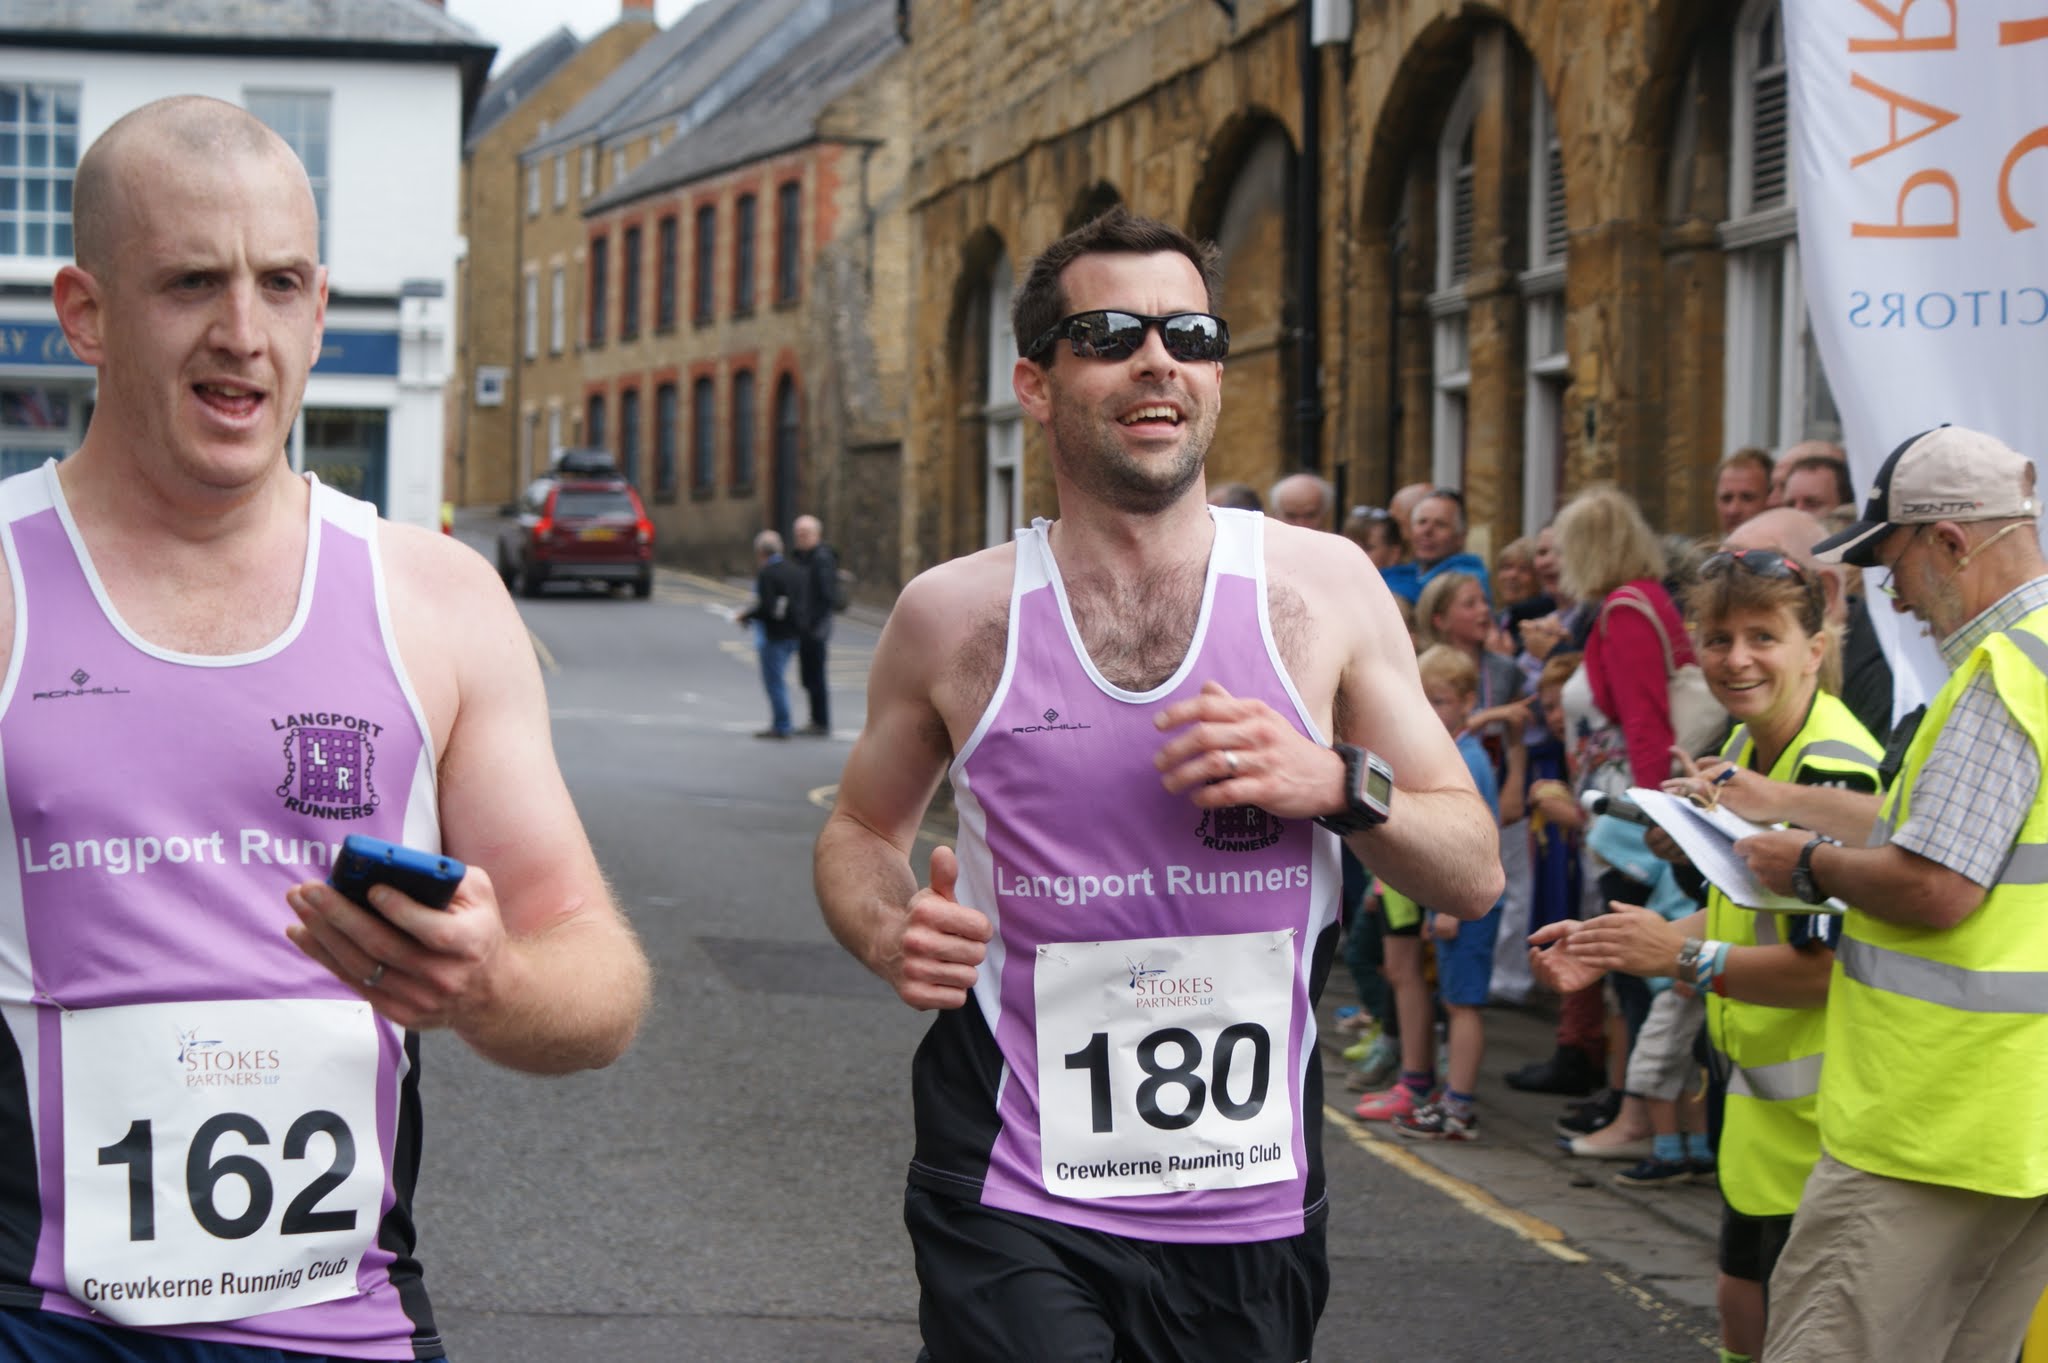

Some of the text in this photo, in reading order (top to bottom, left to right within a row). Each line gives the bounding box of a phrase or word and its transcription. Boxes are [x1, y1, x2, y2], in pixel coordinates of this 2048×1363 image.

[33, 687, 130, 701] RONHILL
[270, 712, 384, 739] LANGPORT
[1011, 723, 1091, 735] RONHILL
[284, 797, 375, 821] RUNNERS
[22, 830, 224, 875] Langport
[1202, 832, 1280, 853] RUNNERS
[997, 863, 1309, 906] Langport Runners
[1135, 976, 1213, 996] STOKES
[1136, 995, 1198, 1008] PARTNERS
[185, 1049, 280, 1073] STOKES
[186, 1073, 262, 1087] PARTNERS
[1064, 1022, 1270, 1133] 180
[1056, 1142, 1281, 1181] Crewkerne Running Club
[98, 1109, 357, 1241] 162
[84, 1257, 348, 1301] Crewkerne Running Club
